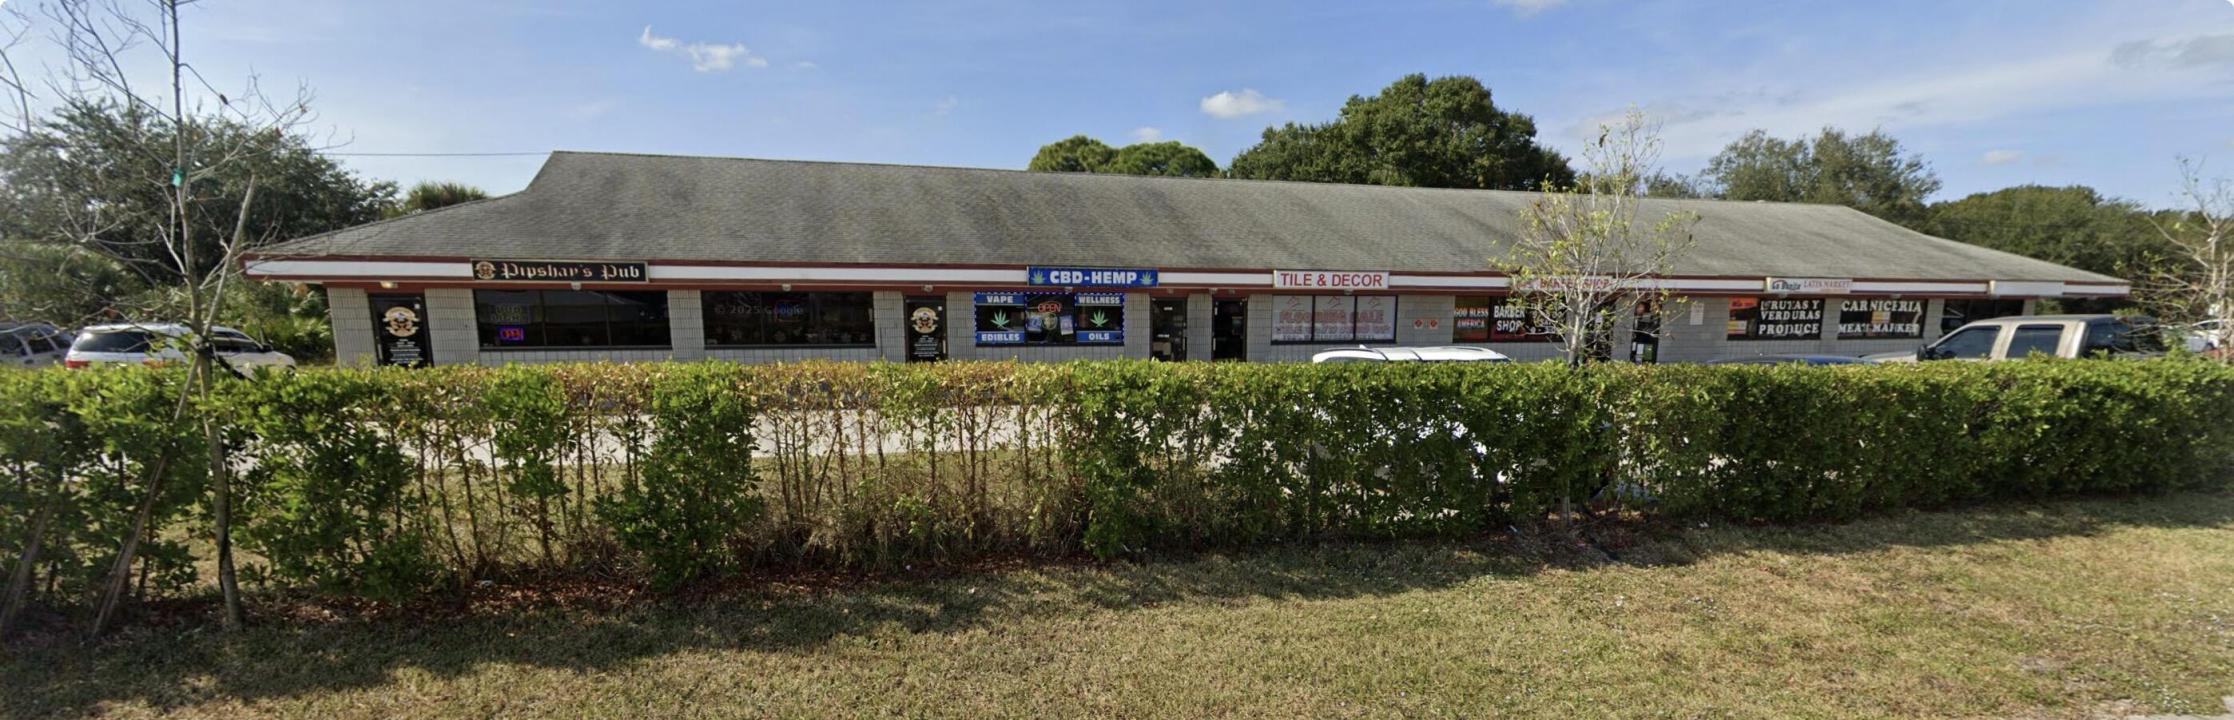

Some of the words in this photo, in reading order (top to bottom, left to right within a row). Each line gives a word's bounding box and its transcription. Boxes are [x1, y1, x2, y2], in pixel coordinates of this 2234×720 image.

[601, 264, 640, 280] Pub
[1050, 271, 1137, 285] CBD-HEMP
[1281, 273, 1311, 287] TILE
[1317, 273, 1326, 286] &
[1332, 274, 1382, 287] DECOR
[1038, 304, 1061, 313] OPEN
[1812, 301, 1820, 309] Y
[1842, 301, 1922, 312] CARNICERIA
[1494, 305, 1526, 318] BARBER
[1761, 311, 1821, 320] VERDURAS
[1457, 320, 1486, 328] AMERICA
[1496, 320, 1521, 332] SHOP
[1759, 324, 1819, 335] PRODUCE
